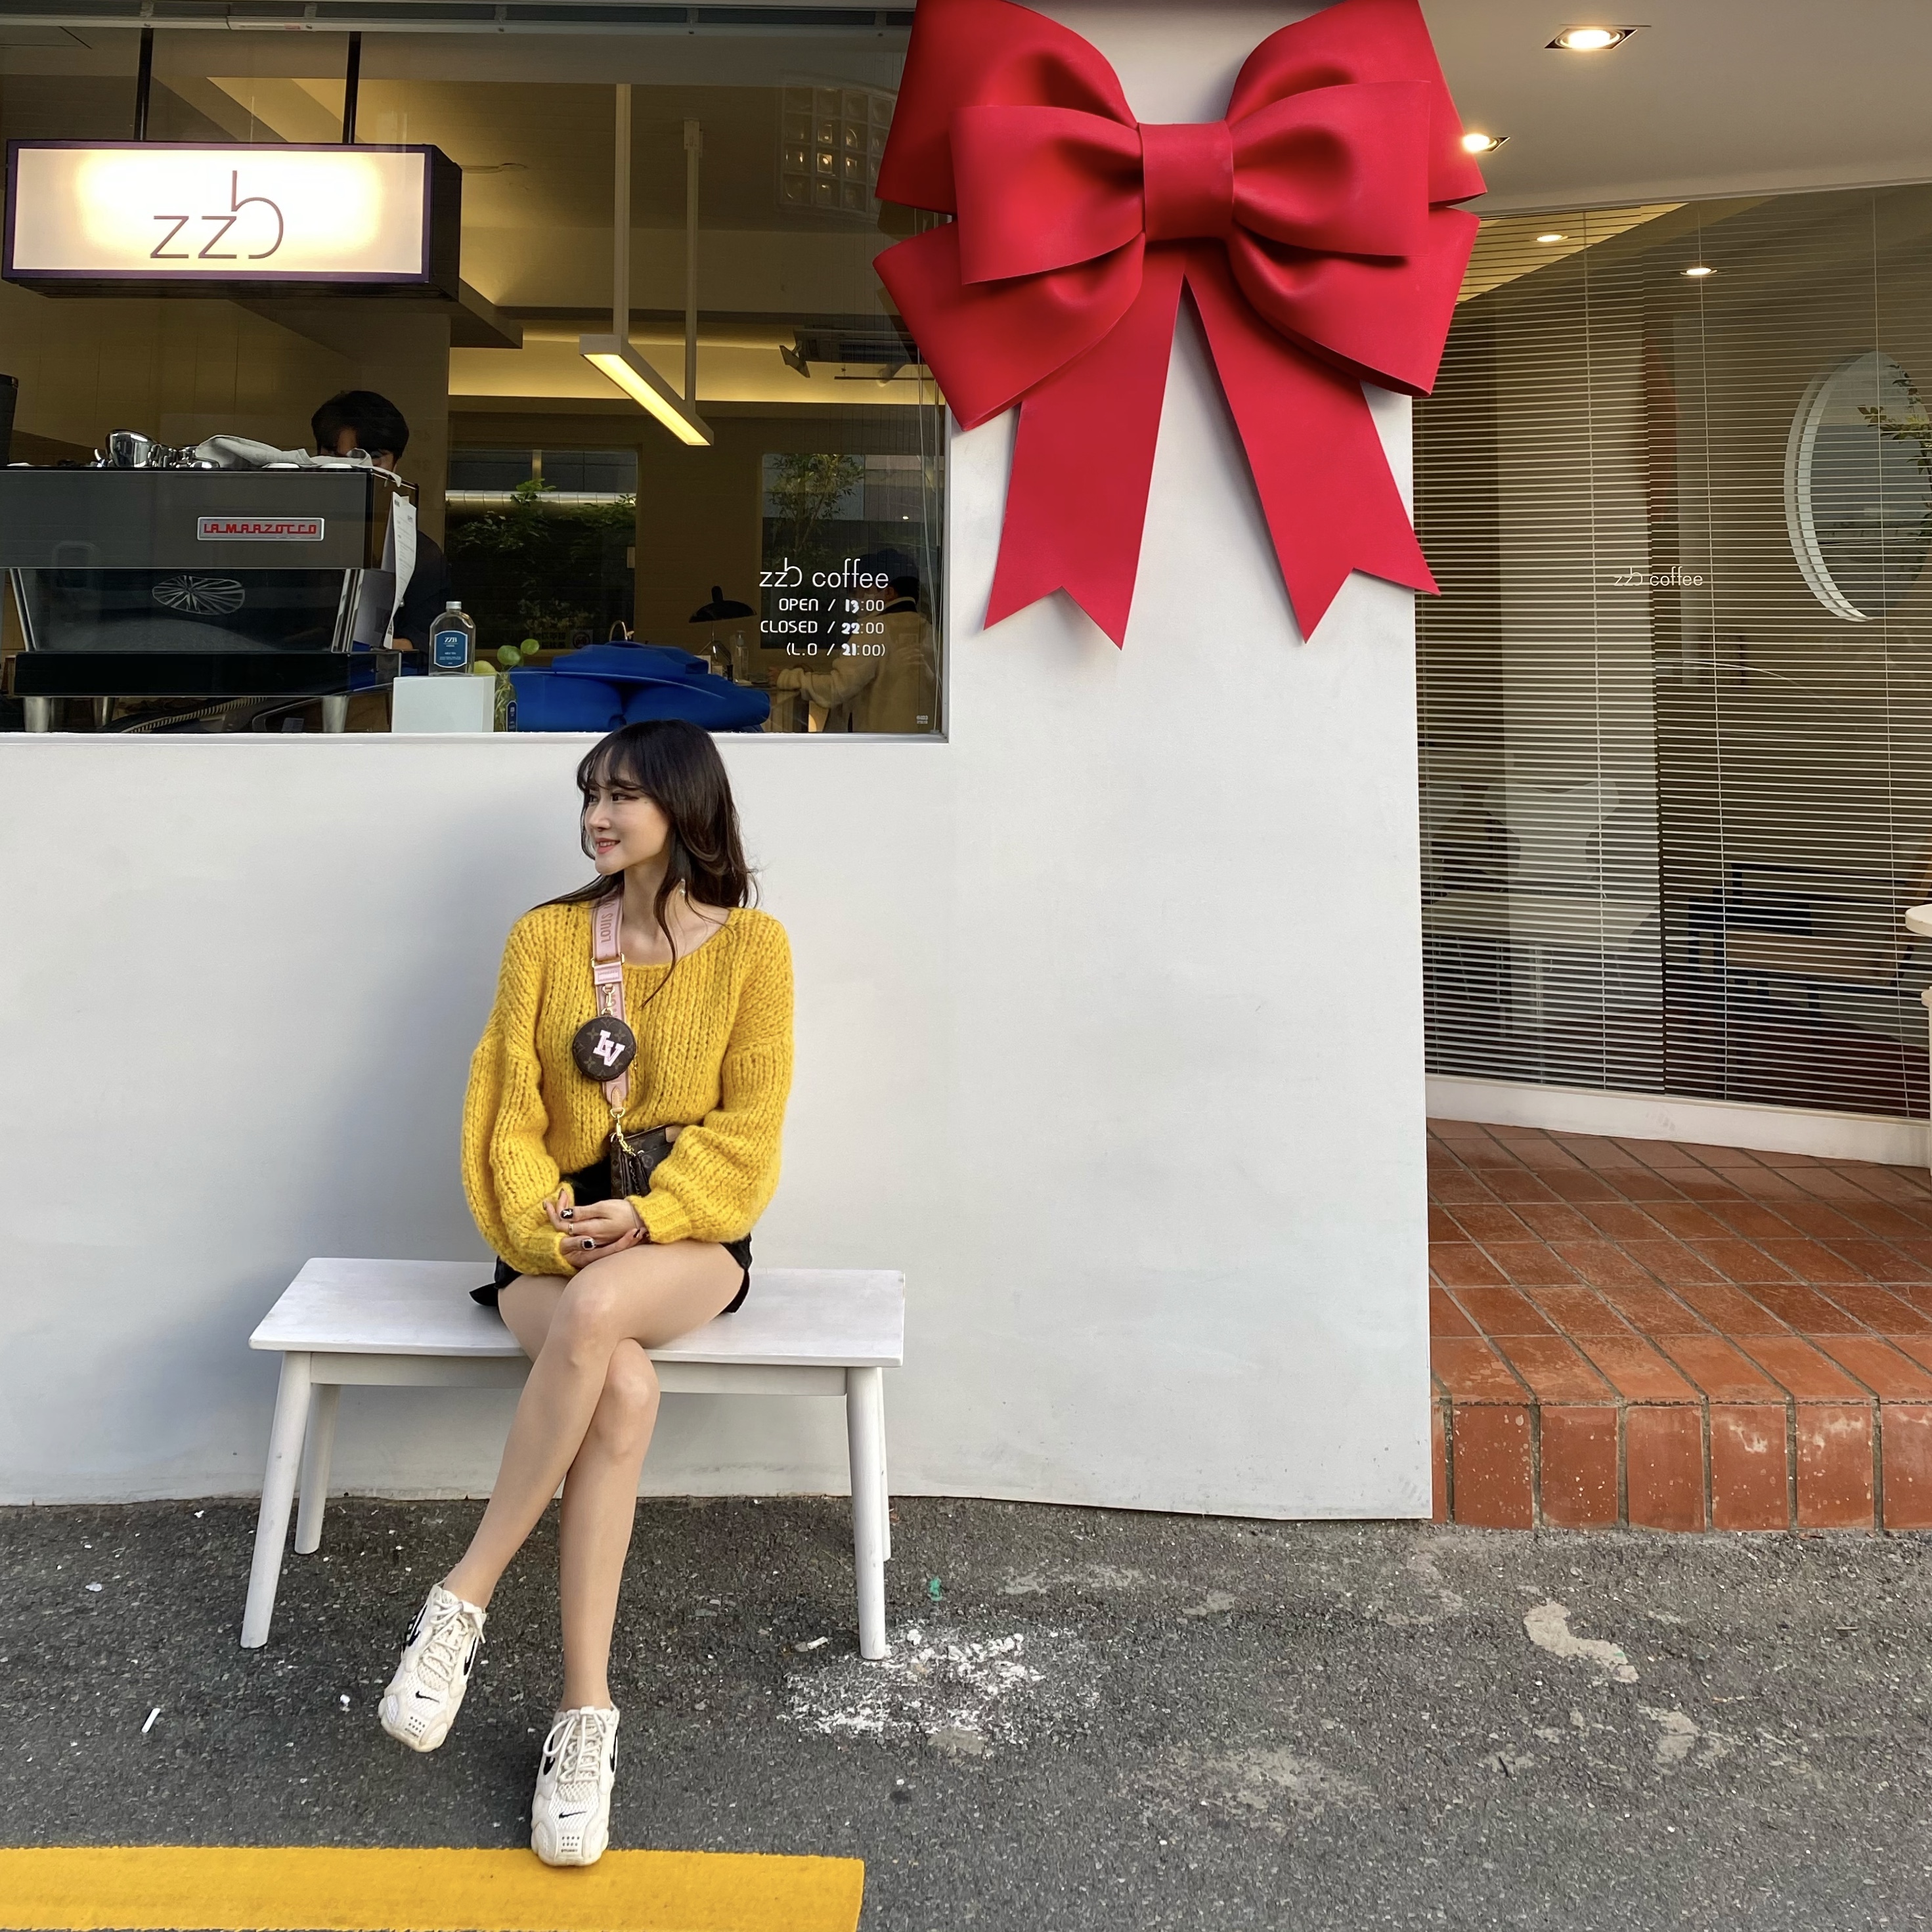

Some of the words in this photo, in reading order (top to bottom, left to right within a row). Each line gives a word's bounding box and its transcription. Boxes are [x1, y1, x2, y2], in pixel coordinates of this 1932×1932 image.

[812, 558, 889, 588] coffee
[1650, 566, 1703, 586] coffee
[779, 598, 819, 611] OPEN
[827, 599, 836, 611] /
[760, 621, 818, 634] CLOSED
[827, 621, 836, 634] /
[841, 622, 885, 635] 22:00
[826, 643, 835, 656] /
[600, 913, 613, 943] LOUIS
